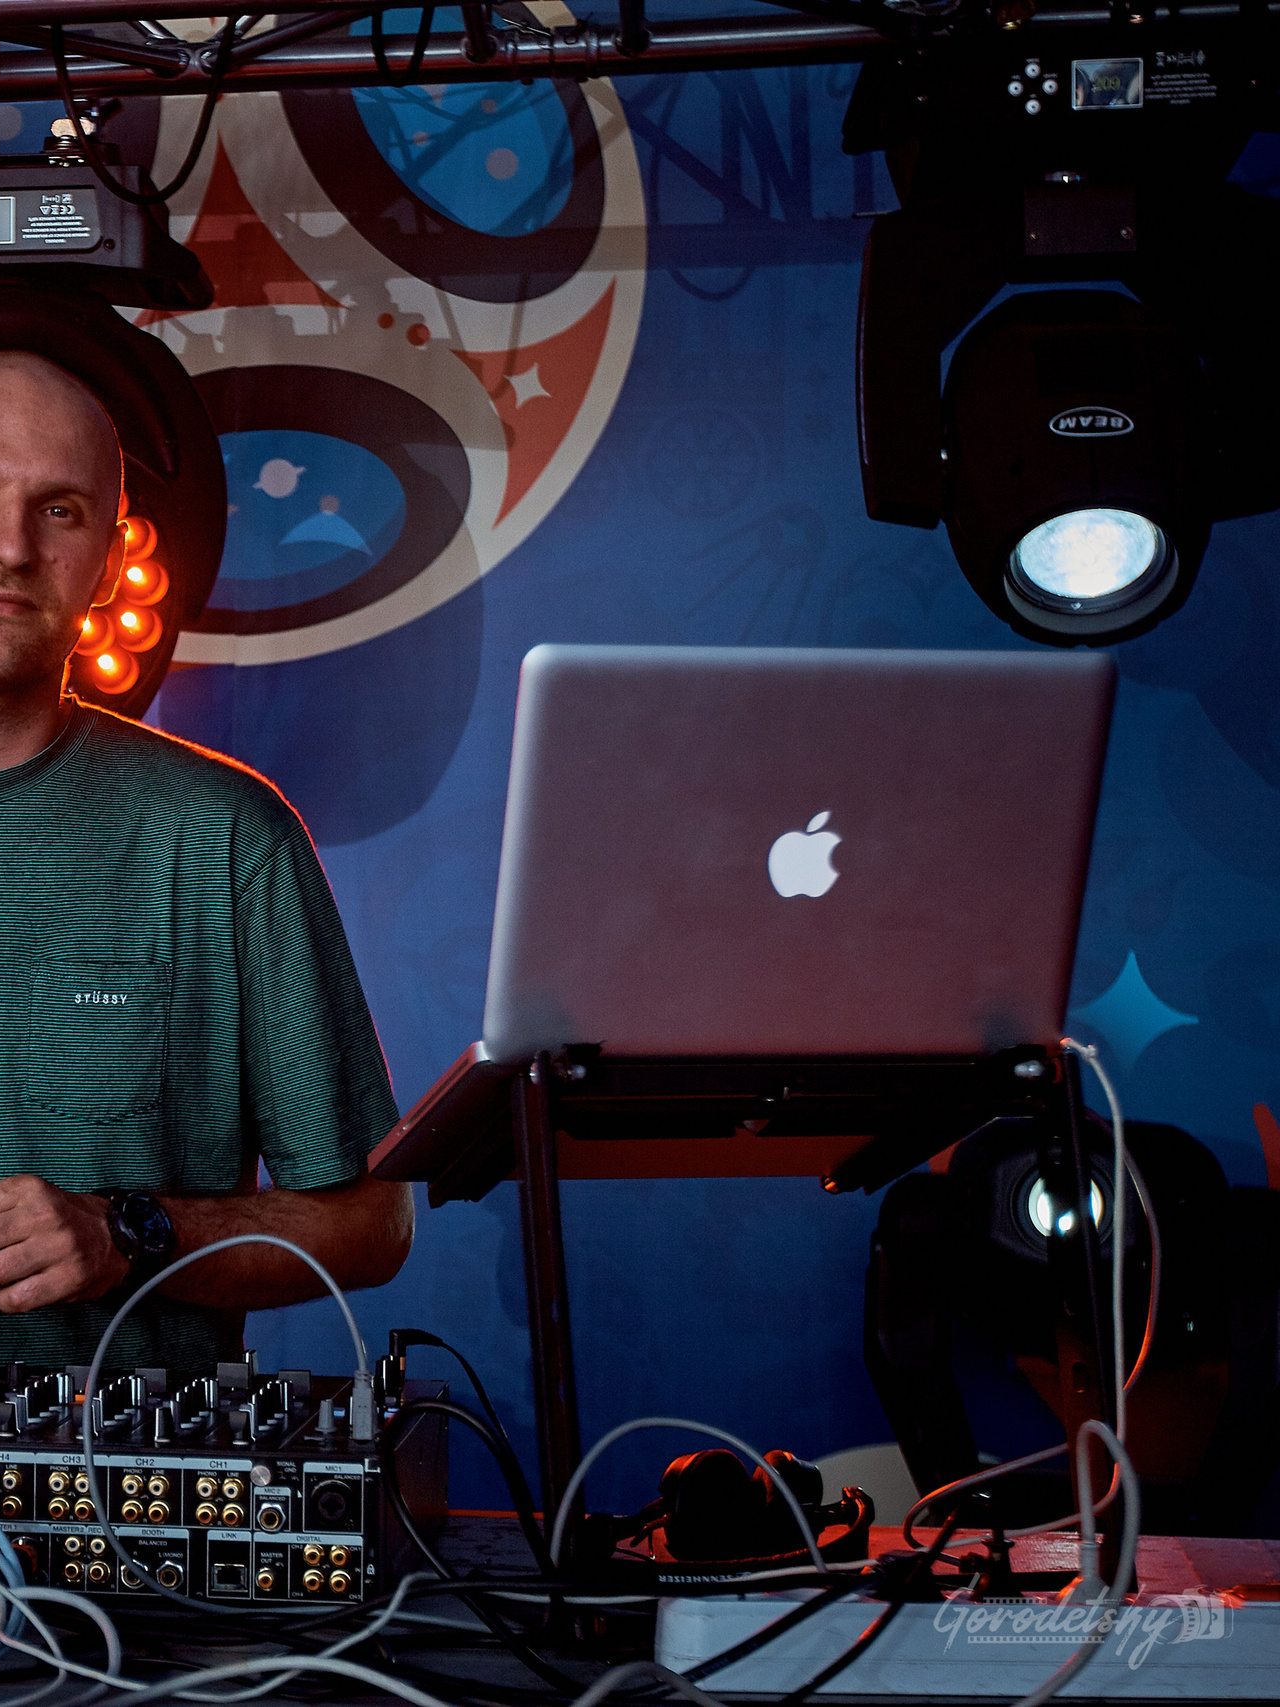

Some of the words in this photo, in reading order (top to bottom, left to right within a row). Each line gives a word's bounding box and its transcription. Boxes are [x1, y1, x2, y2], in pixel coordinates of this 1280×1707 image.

[1058, 415, 1123, 430] BEAM
[74, 990, 127, 1004] STÜSSY
[62, 1456, 81, 1464] CH3
[659, 1575, 732, 1583] SENNHEISER
